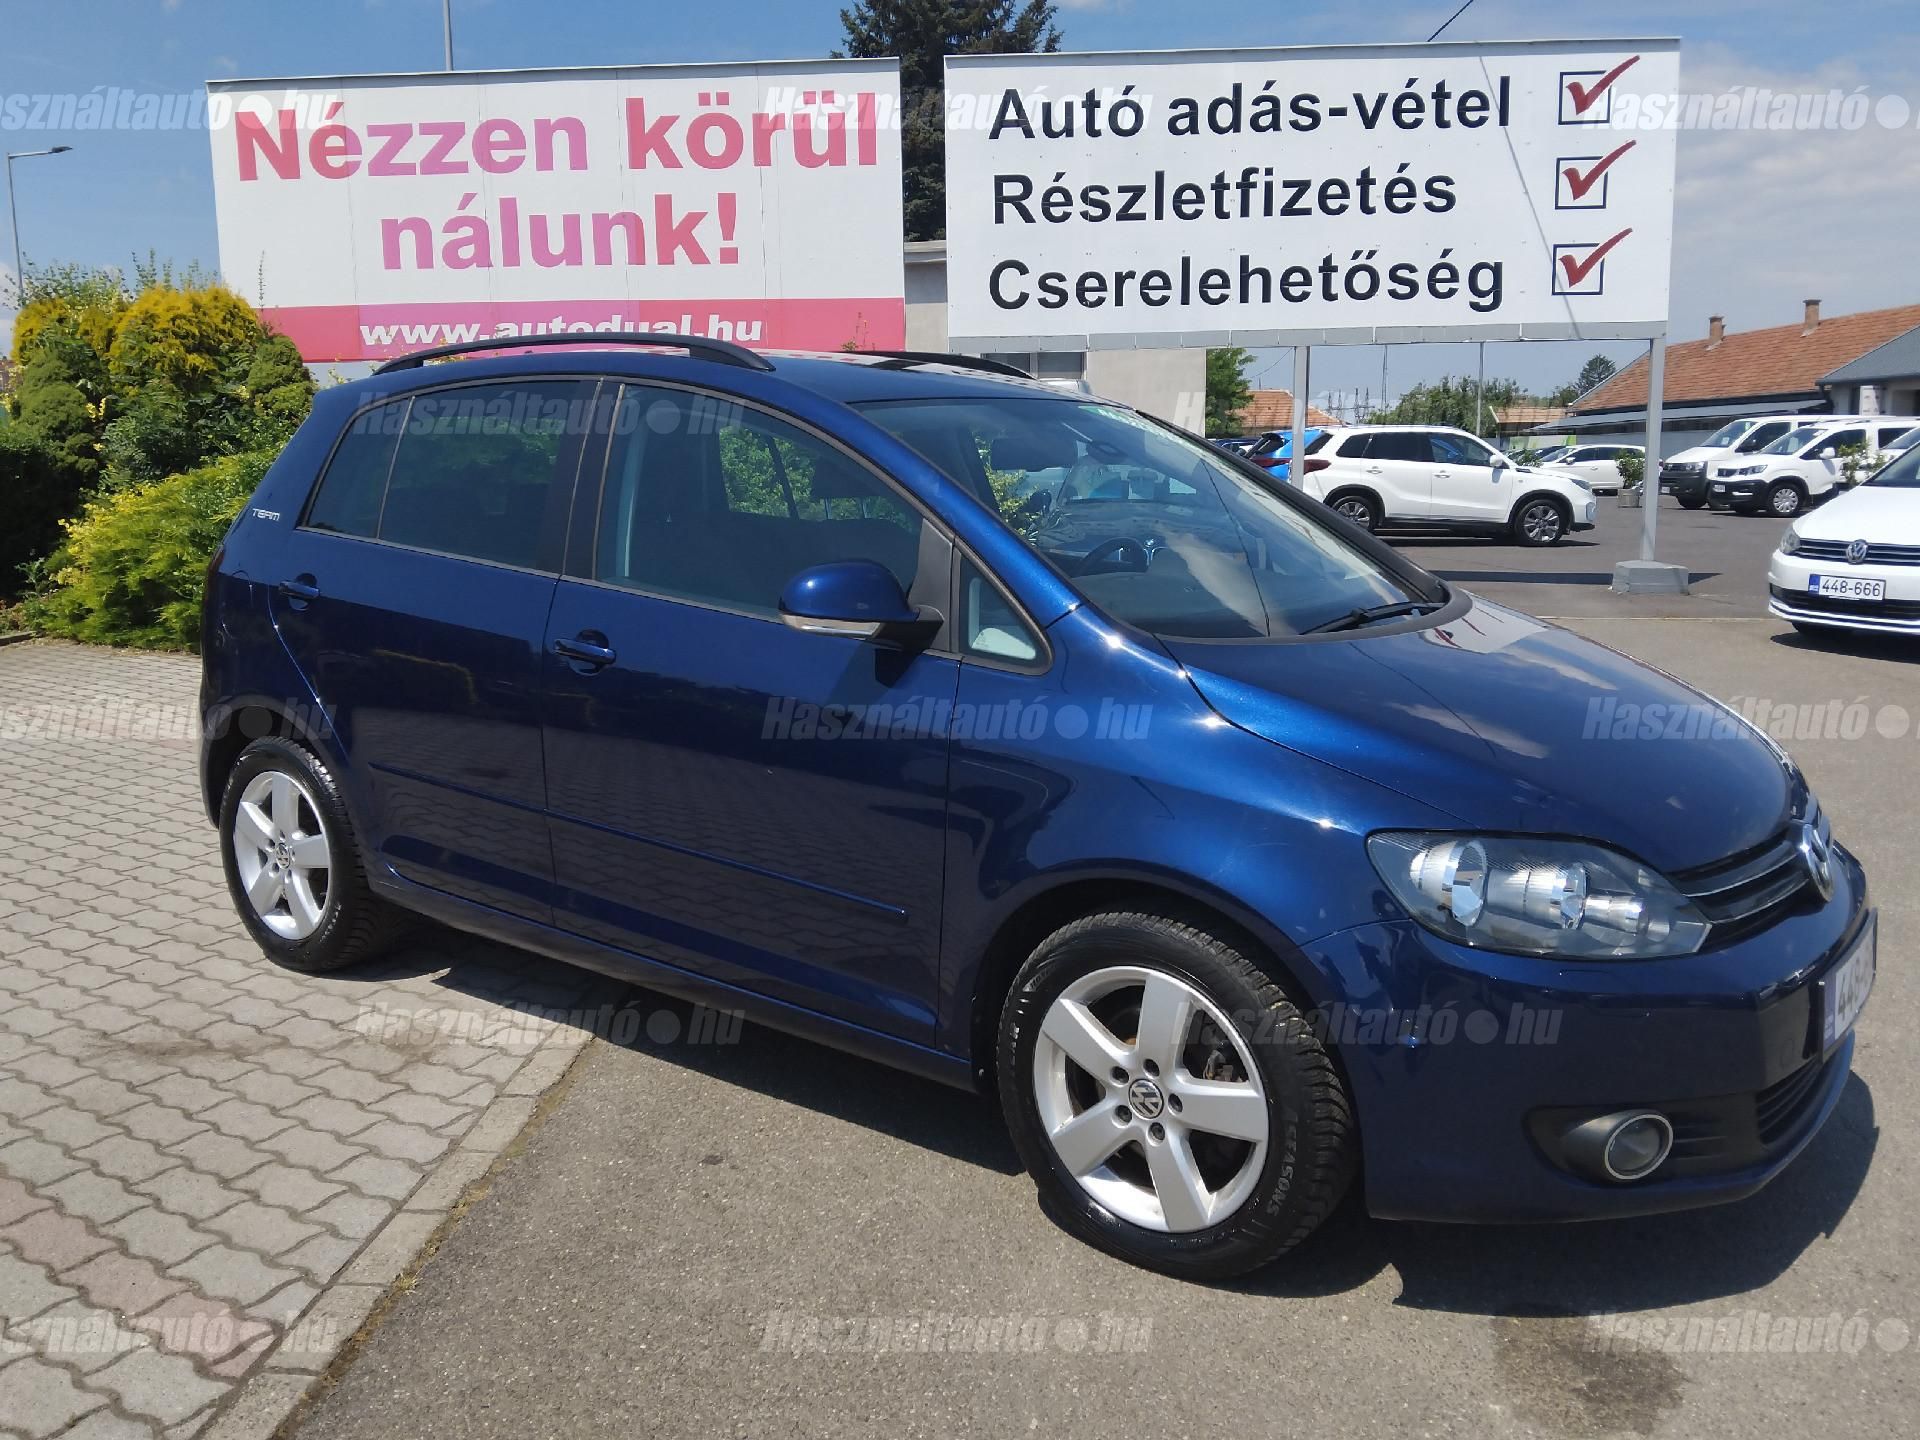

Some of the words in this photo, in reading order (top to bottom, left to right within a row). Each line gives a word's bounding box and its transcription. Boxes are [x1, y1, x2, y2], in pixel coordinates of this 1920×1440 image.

[234, 101, 589, 181] Nézzen
[626, 91, 877, 169] körül
[988, 84, 1144, 140] Autó
[1167, 75, 1511, 135] adás-vétel
[993, 162, 1457, 225] Részletfizetés
[380, 192, 739, 270] nálunk!
[988, 248, 1504, 313] Cserelehetőség
[252, 508, 280, 521] TEAM
[1821, 578, 1882, 598] 448-666
